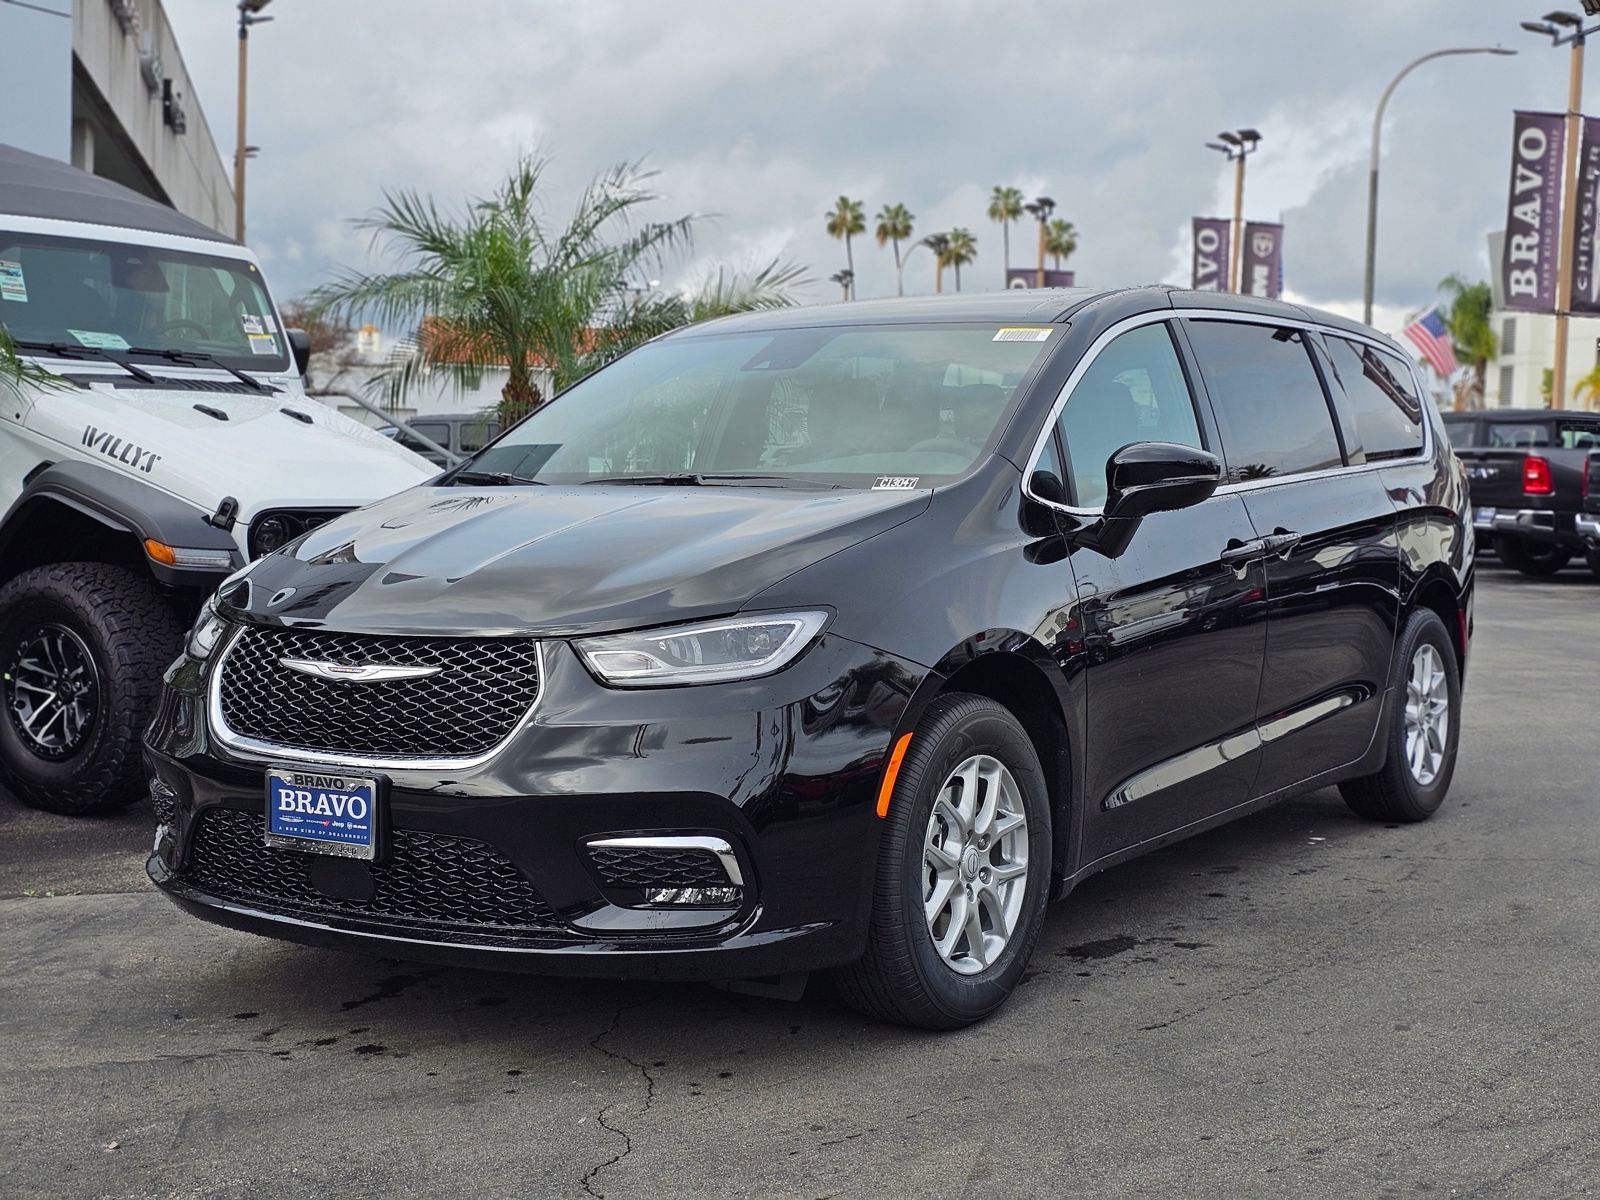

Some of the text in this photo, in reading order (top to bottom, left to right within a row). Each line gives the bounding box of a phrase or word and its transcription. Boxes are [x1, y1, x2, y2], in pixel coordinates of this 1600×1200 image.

[1509, 126, 1547, 298] BRAVO
[1577, 145, 1600, 291] CHRYSLER
[1543, 228, 1552, 257] KIND
[294, 774, 345, 790] BRAVO
[278, 789, 367, 819] BRAVO
[332, 820, 345, 829] Jeep
